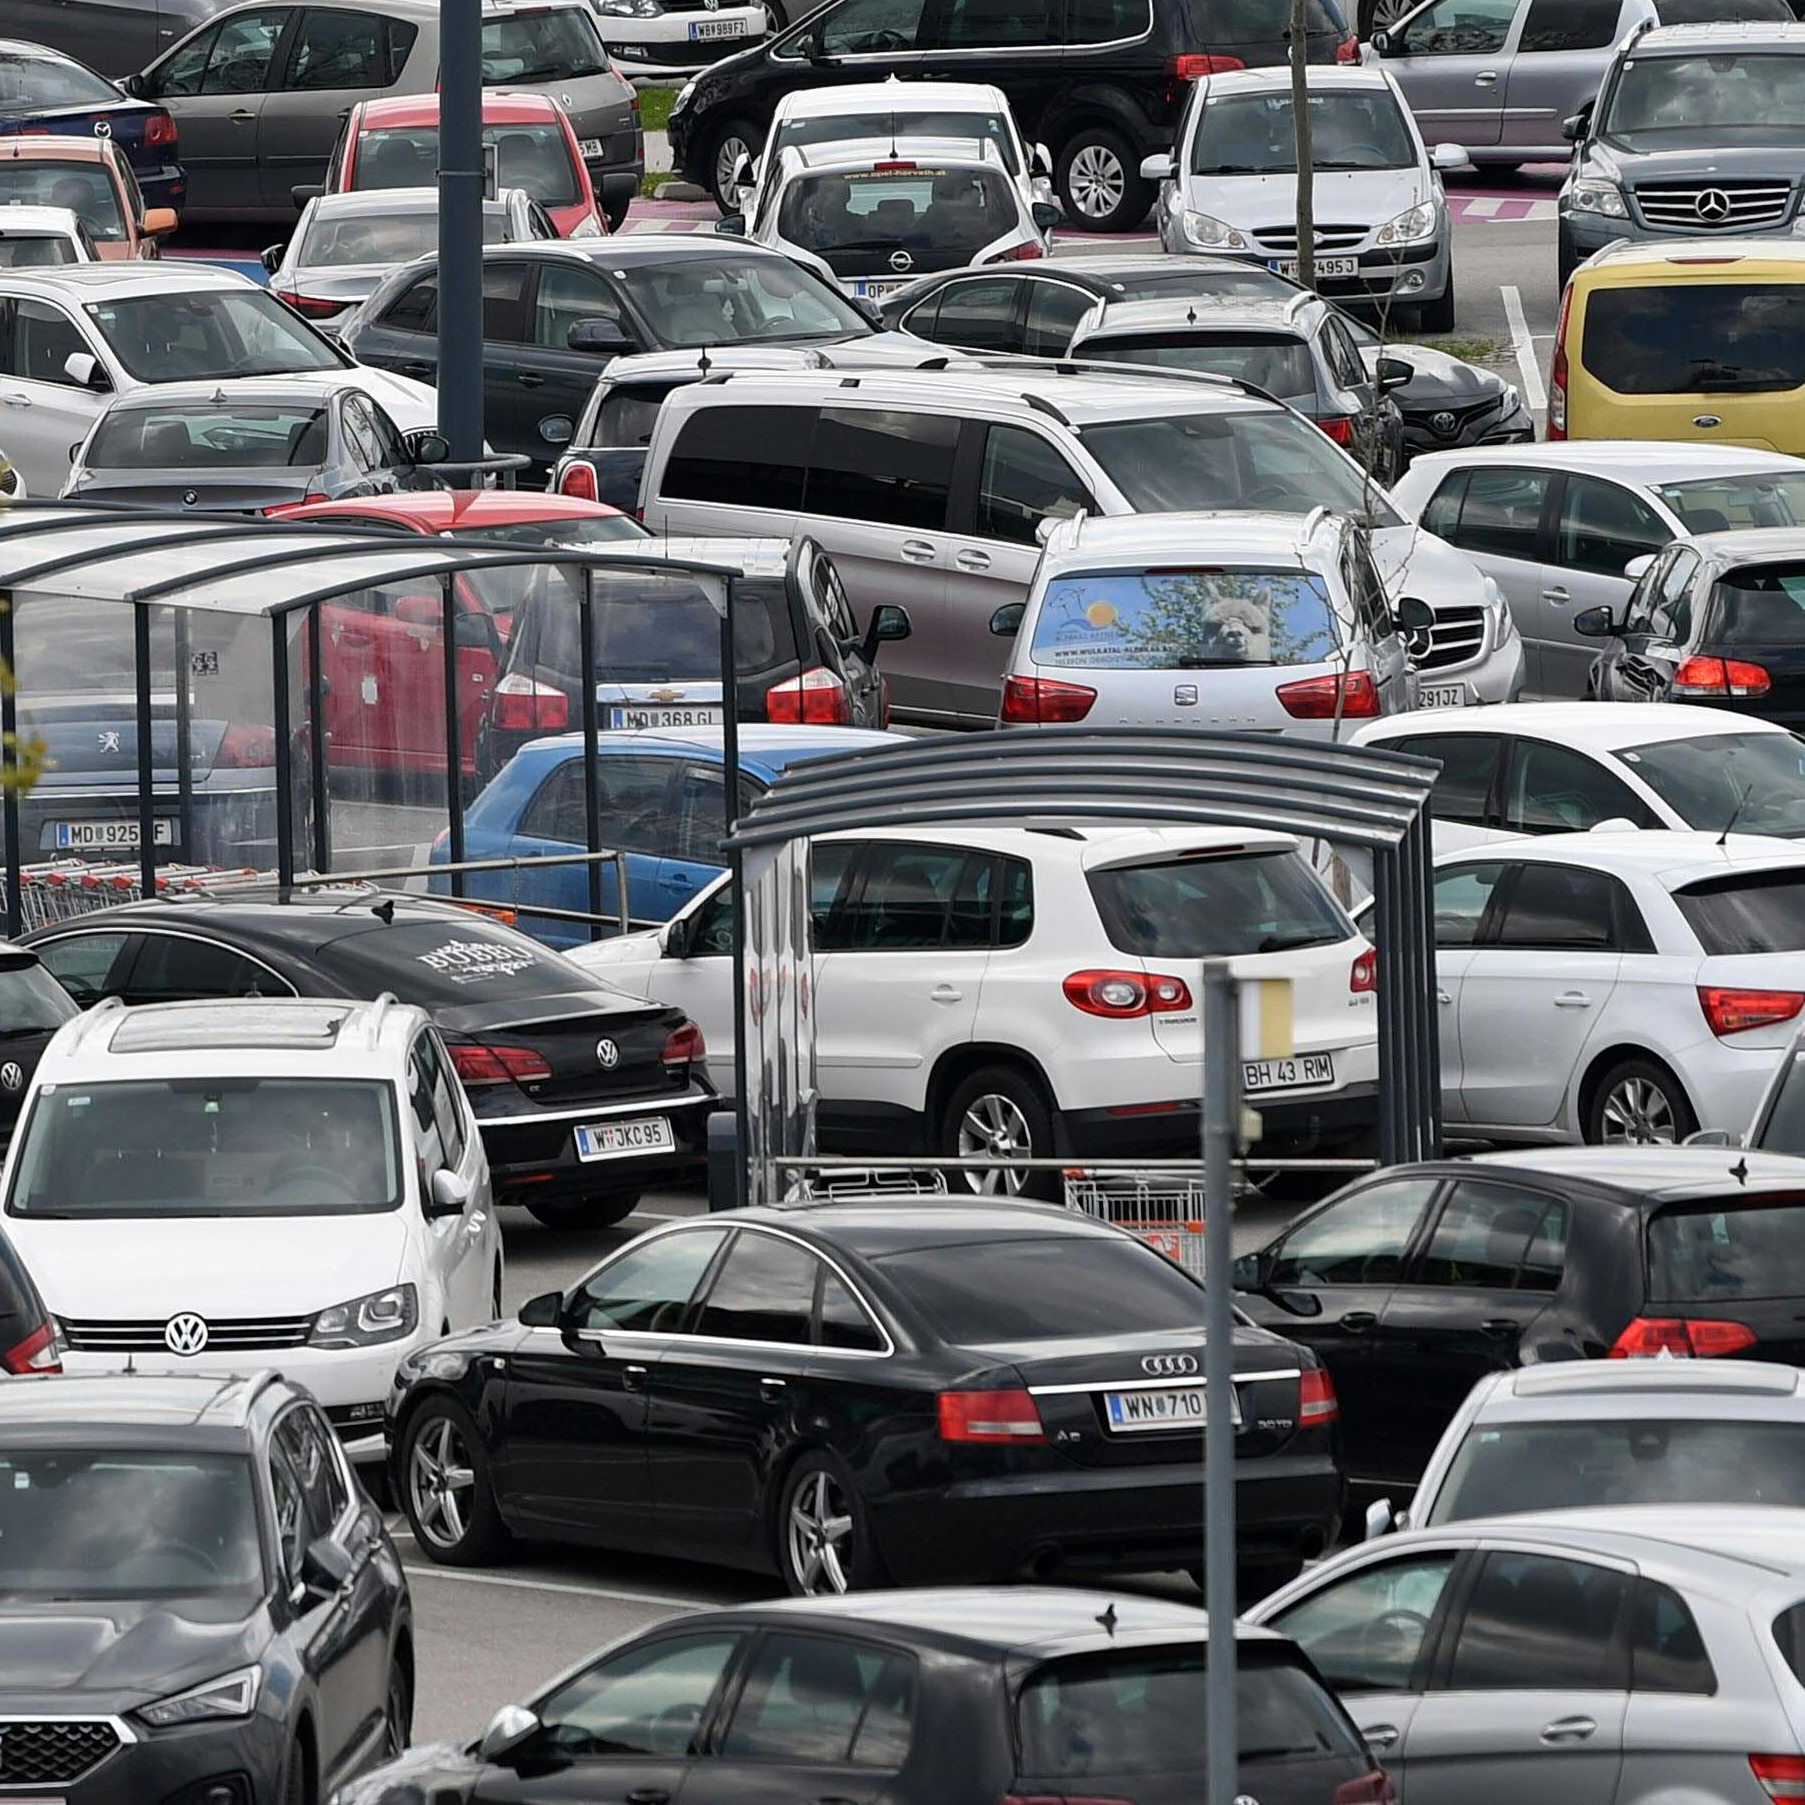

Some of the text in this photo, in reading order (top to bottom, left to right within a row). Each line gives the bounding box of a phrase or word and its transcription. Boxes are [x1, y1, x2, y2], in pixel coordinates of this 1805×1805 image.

[699, 23, 712, 37] WB
[72, 827, 93, 843] MD
[1245, 1058, 1333, 1088] BH 43 RIM
[1126, 1398, 1156, 1419] WN
